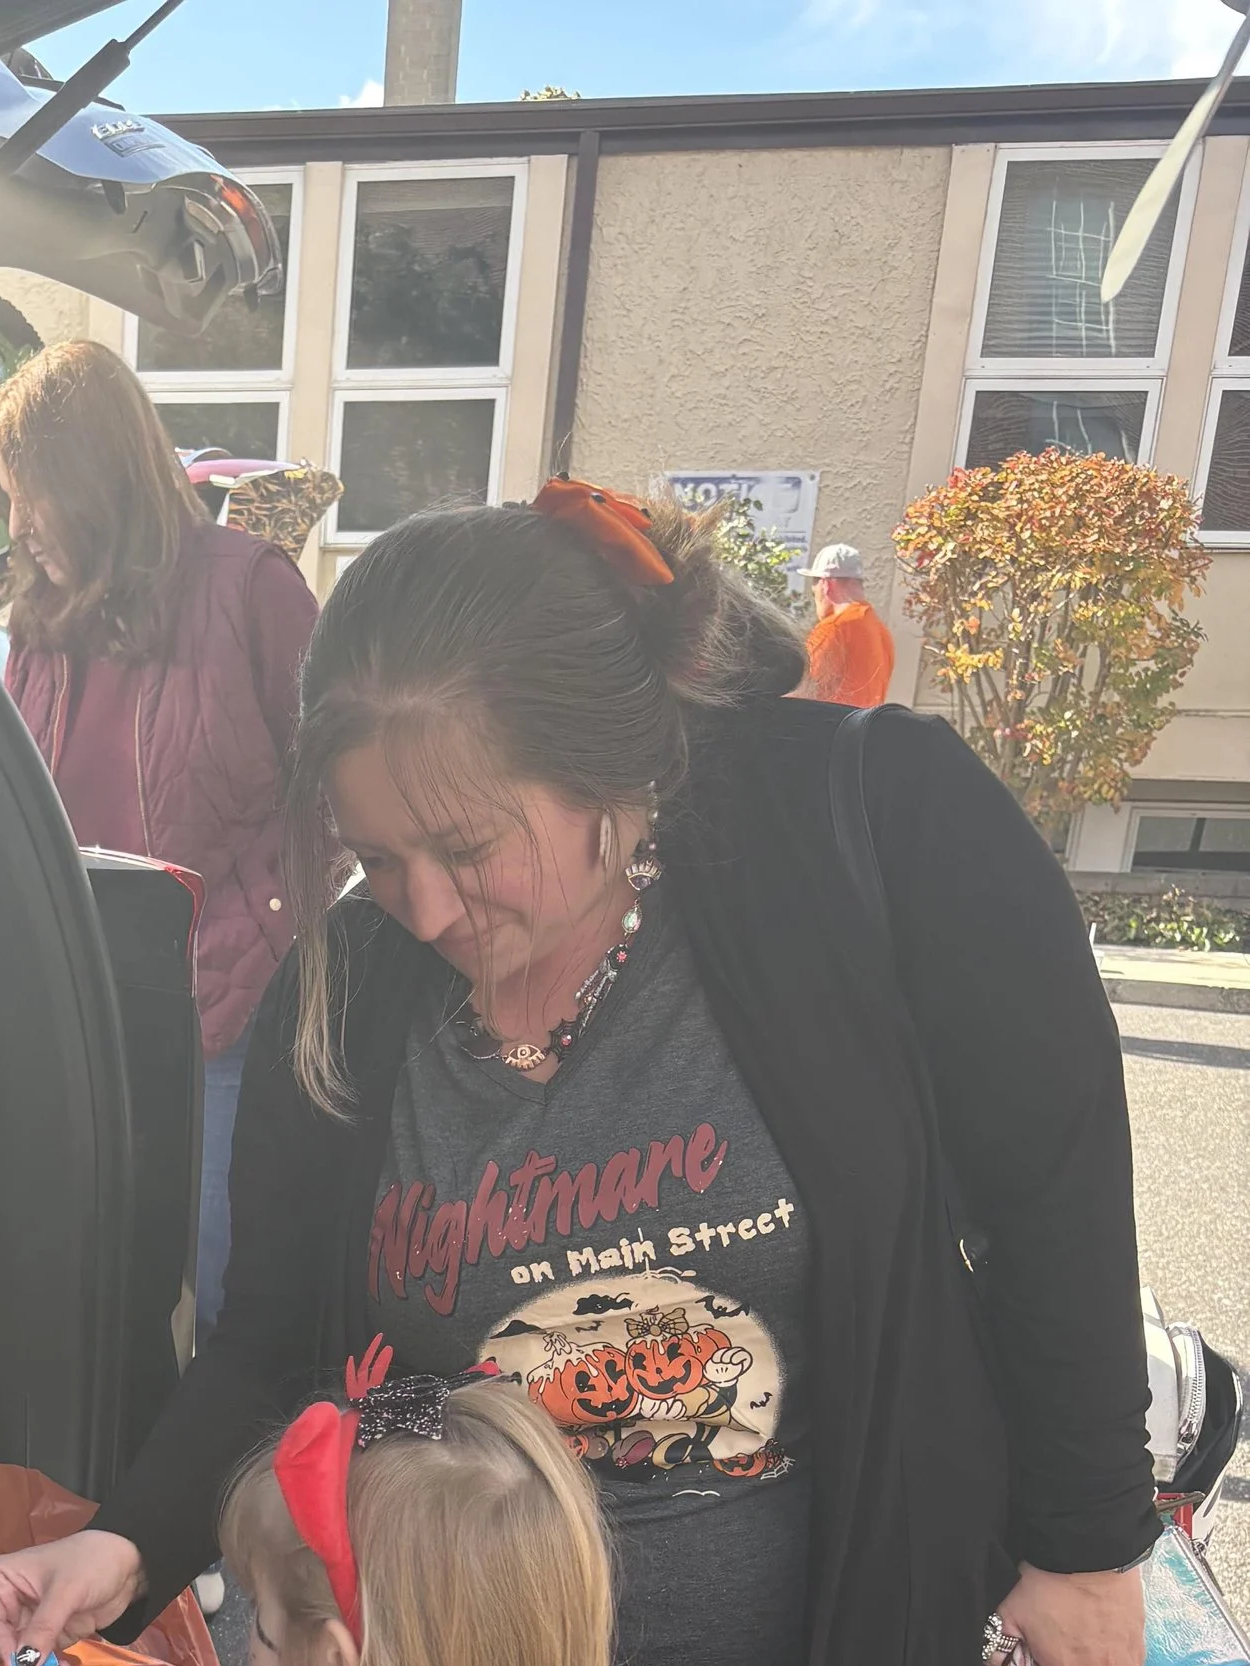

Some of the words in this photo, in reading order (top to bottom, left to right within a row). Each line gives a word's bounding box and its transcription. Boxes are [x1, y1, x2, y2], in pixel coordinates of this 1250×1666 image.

[368, 1122, 729, 1316] Nightmare
[510, 1260, 555, 1285] on
[566, 1233, 656, 1276] Main
[668, 1198, 795, 1257] Street
